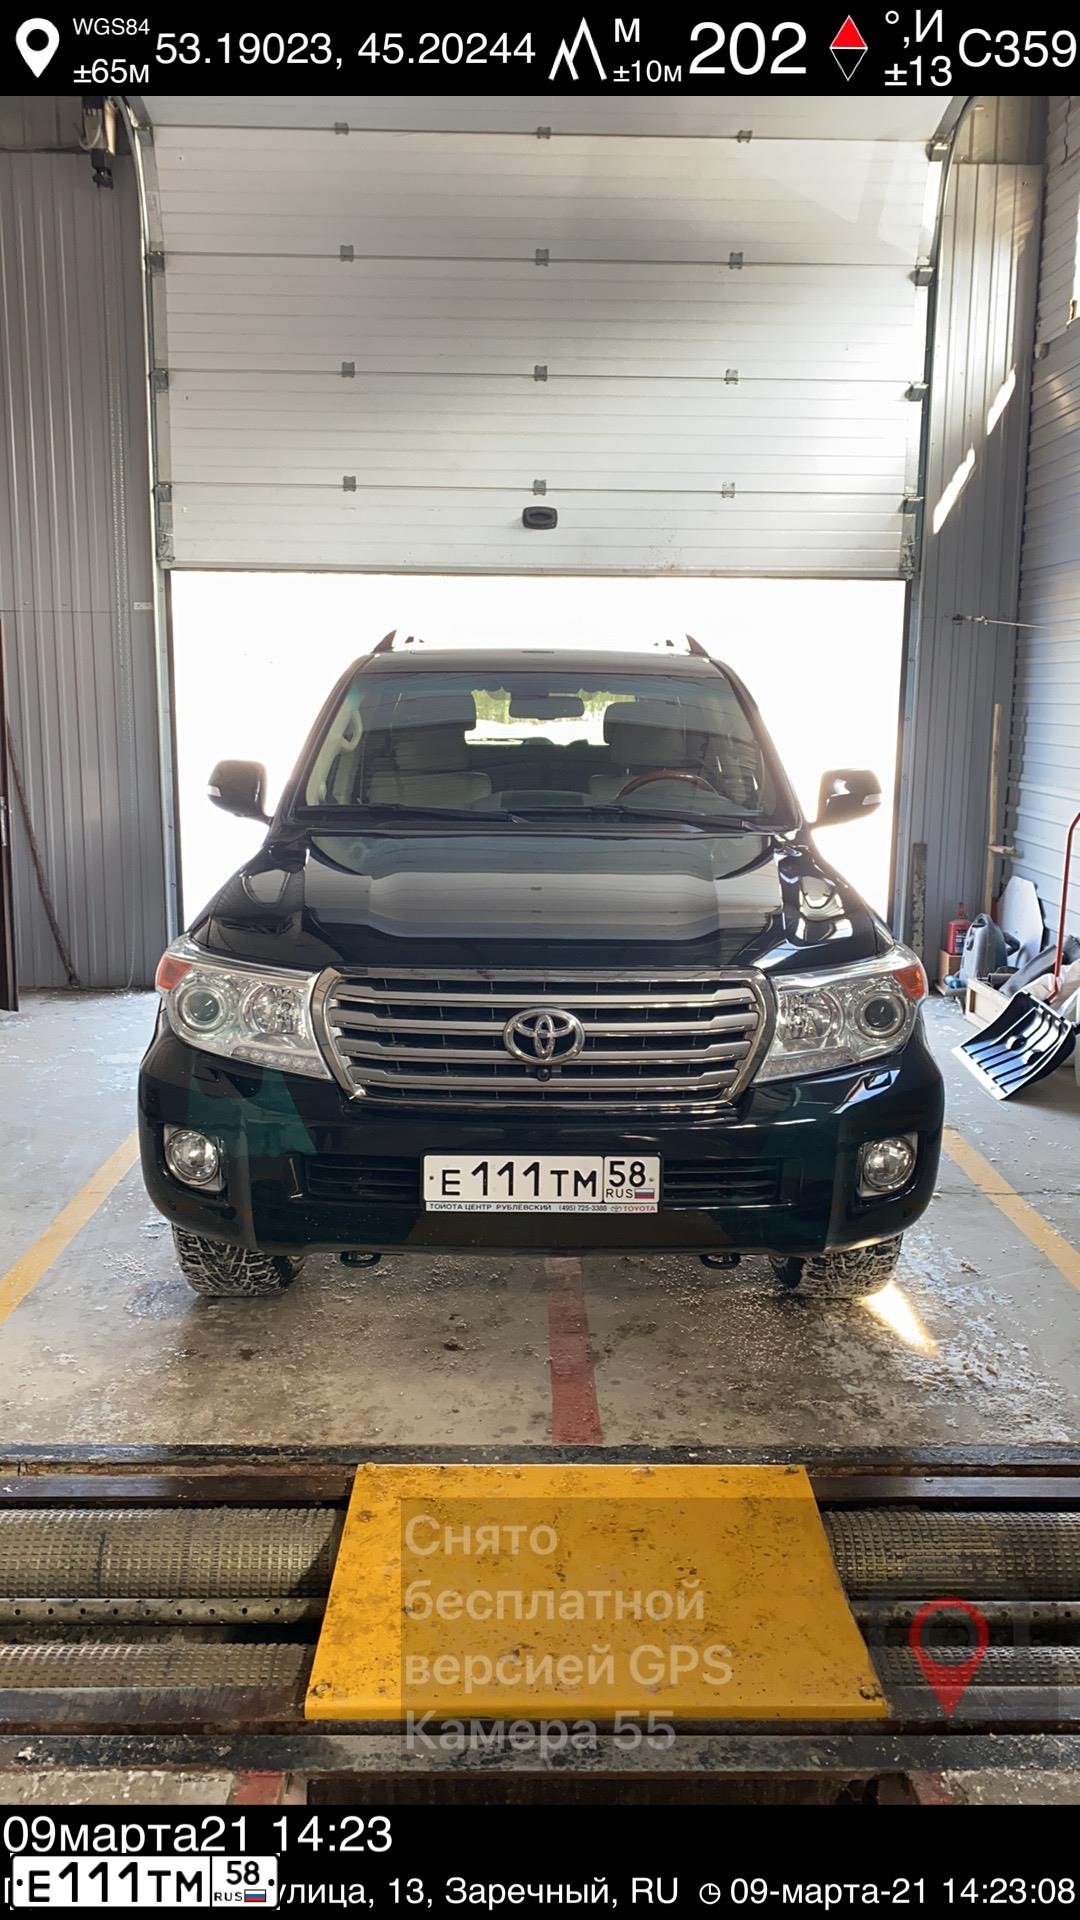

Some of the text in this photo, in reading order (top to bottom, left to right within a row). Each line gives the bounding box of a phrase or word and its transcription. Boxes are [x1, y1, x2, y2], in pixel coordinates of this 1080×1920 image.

[608, 1160, 646, 1188] 58
[606, 1188, 633, 1199] RUS
[465, 1203, 493, 1211] ЦЕНТР
